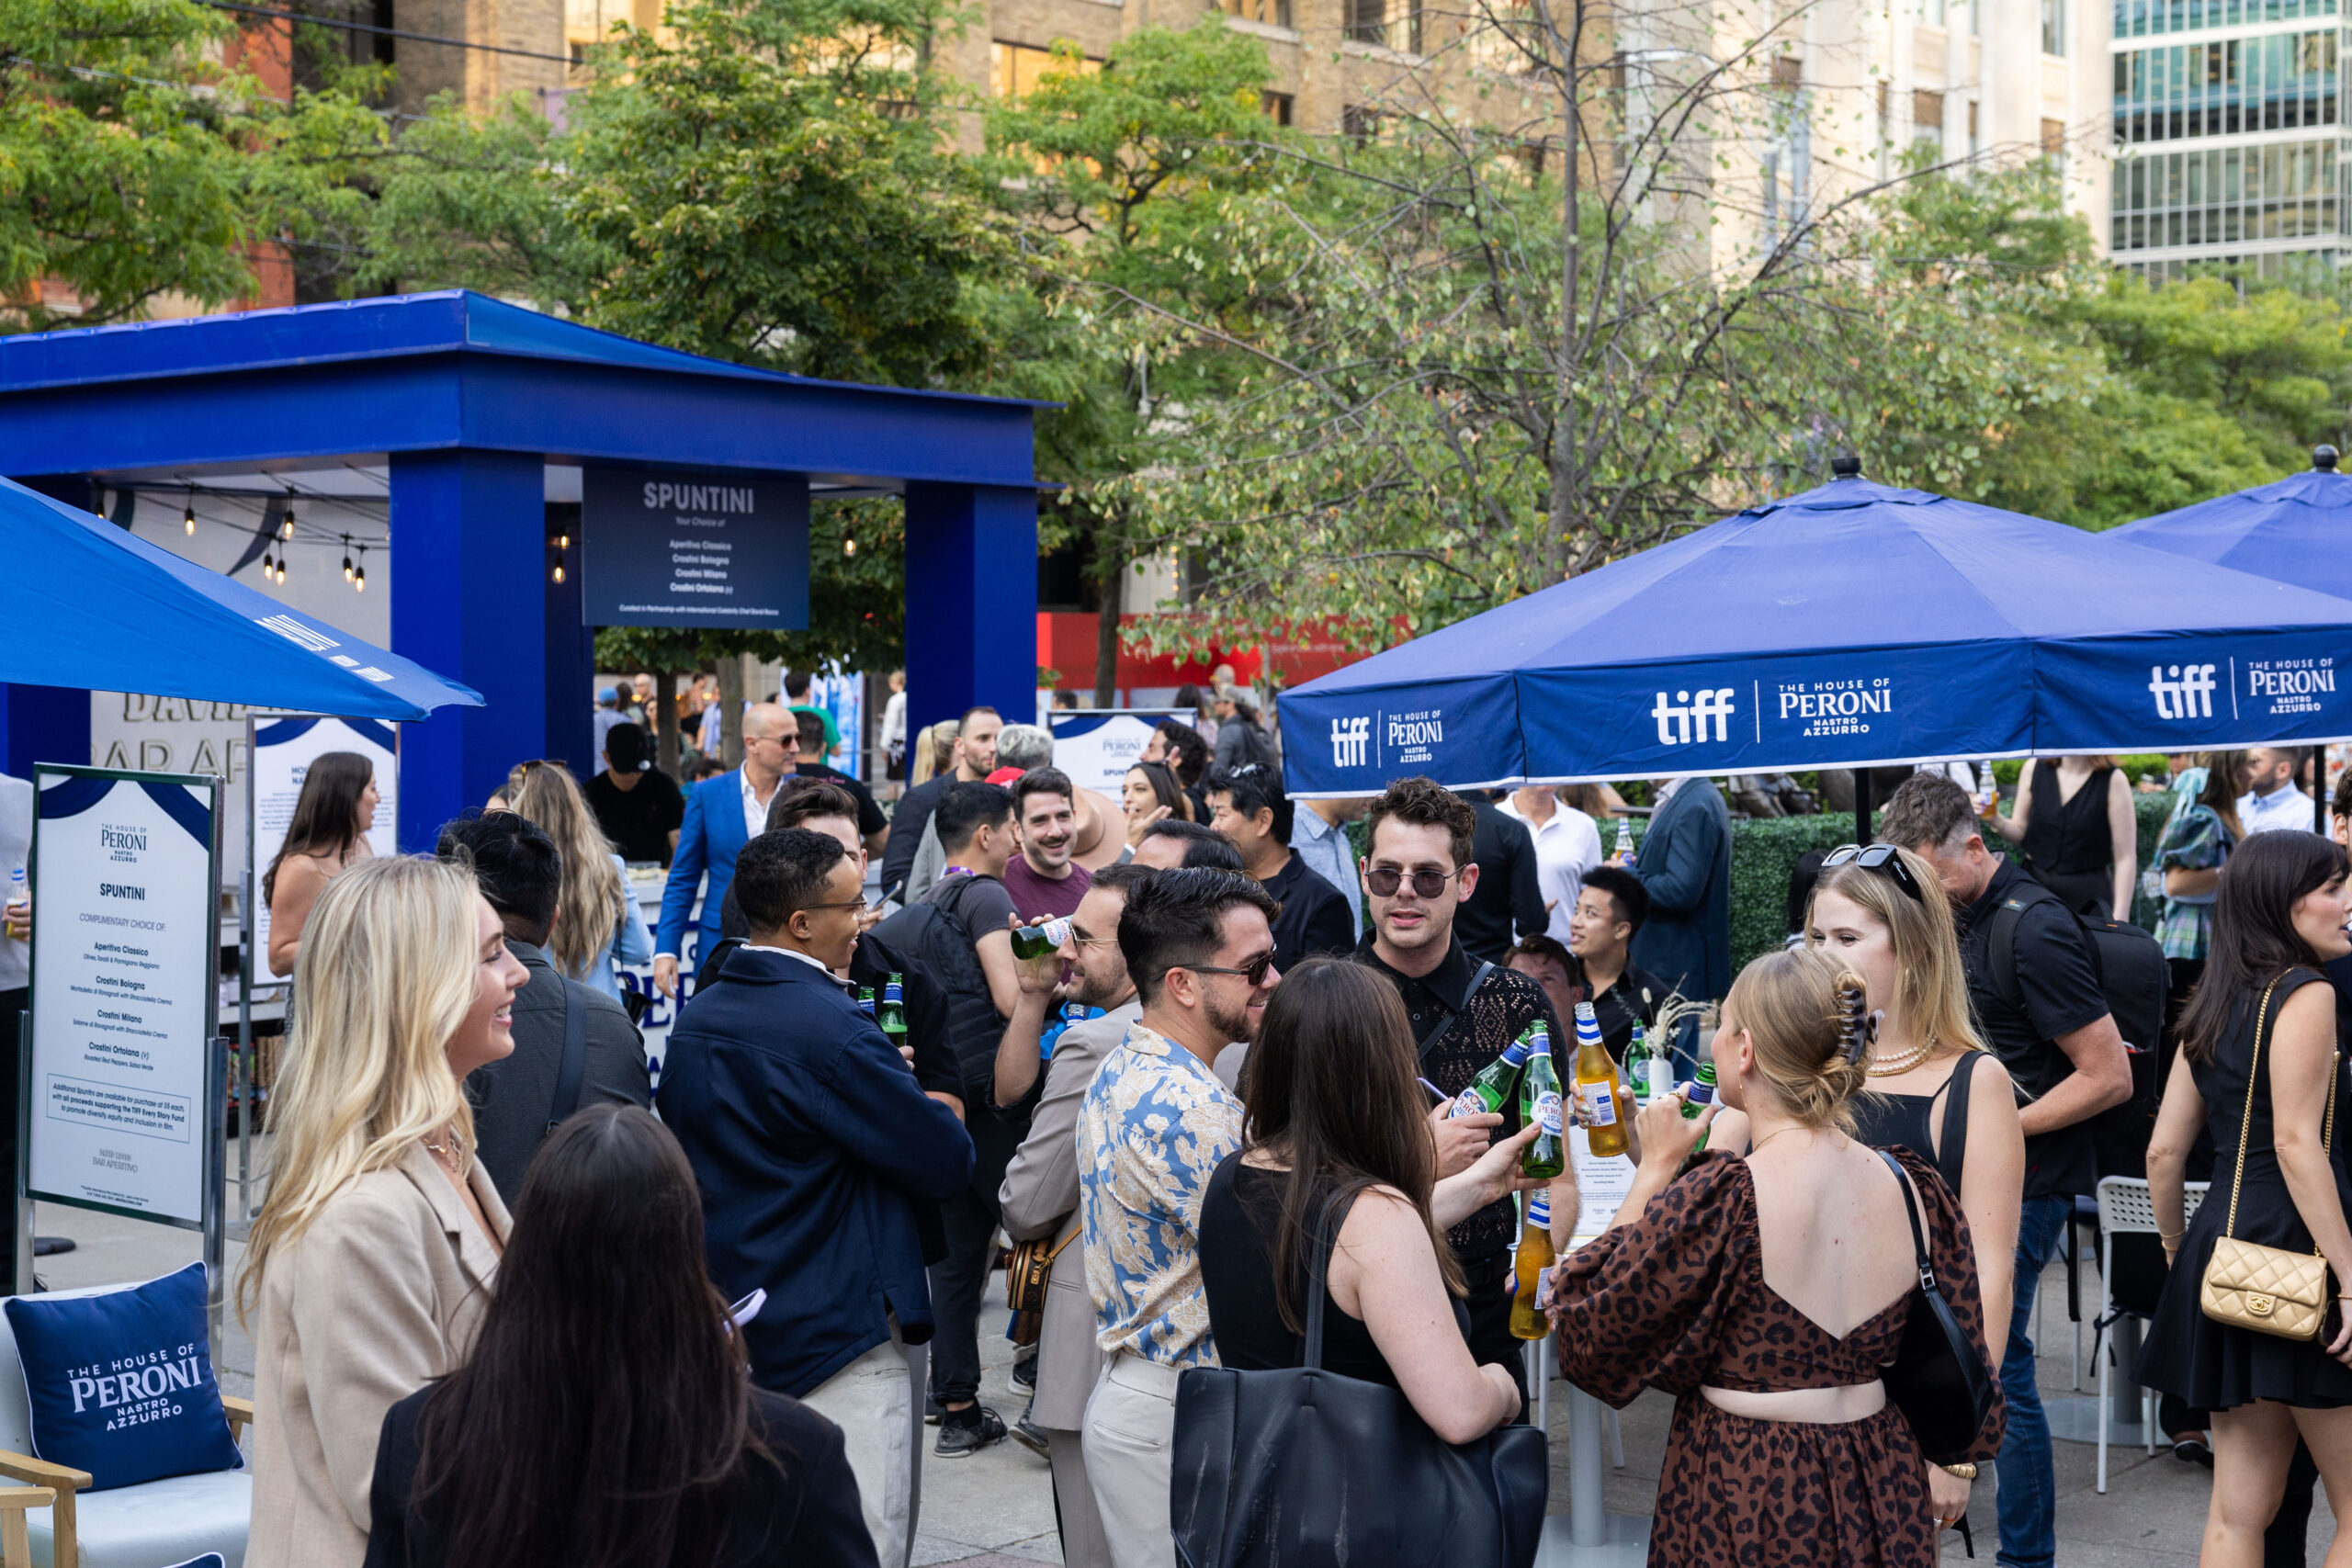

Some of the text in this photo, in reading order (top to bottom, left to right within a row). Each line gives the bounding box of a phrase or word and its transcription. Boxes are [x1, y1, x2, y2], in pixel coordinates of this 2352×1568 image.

[644, 481, 754, 513] SPUNTINI
[2248, 658, 2333, 671] THE HOUSE OF
[1779, 678, 1890, 692] THE HOUSE OF
[2148, 664, 2216, 719] tiff
[2250, 669, 2335, 696] PERONI
[1779, 689, 1892, 719] PERONI
[2270, 703, 2321, 714] AZZURRO
[2277, 695, 2312, 704] NASTRO
[1389, 710, 1441, 722] THE HOUSE OF
[1652, 688, 1735, 745] tiff
[1814, 717, 1858, 727] NASTRO
[1388, 721, 1442, 746] PERONI
[1803, 725, 1870, 737] AZZURRO
[1330, 716, 1370, 768] tiff
[1405, 746, 1427, 754] NASTRO
[1400, 753, 1432, 763] AZZURRO
[101, 829, 147, 851] PERONI
[110, 855, 137, 863] AZZURRO
[100, 883, 145, 901] SPUNTINI
[79, 913, 167, 931] COMPLIMENTARY CHOICE OF:
[95, 942, 149, 956] Aperitivo Classico
[96, 976, 145, 991] Crostini Bologna
[97, 1010, 142, 1023] Crostini Milano
[89, 1042, 111, 1053] Crostini
[113, 1045, 140, 1057] Ortolana
[53, 1083, 76, 1093] Additional
[77, 1087, 96, 1096] Spuntini
[105, 1093, 126, 1101] available
[134, 1098, 156, 1107] purchase
[70, 1097, 94, 1107] proceeds
[95, 1101, 121, 1113] supporting
[131, 1106, 141, 1114] TIFF
[142, 1108, 156, 1119] Every
[157, 1111, 171, 1121] Story
[172, 1113, 185, 1122] Fund
[1457, 1095, 1478, 1115] PERO
[66, 1106, 86, 1115] promote
[107, 1114, 123, 1122] equity
[135, 1119, 156, 1127] inclusion
[92, 1156, 138, 1173] BAR APERITIVO
[67, 1343, 195, 1379] THE HOUSE OF
[69, 1356, 202, 1414] PERONI
[117, 1397, 169, 1417] NASTRO
[106, 1404, 183, 1431] AZZURRO
